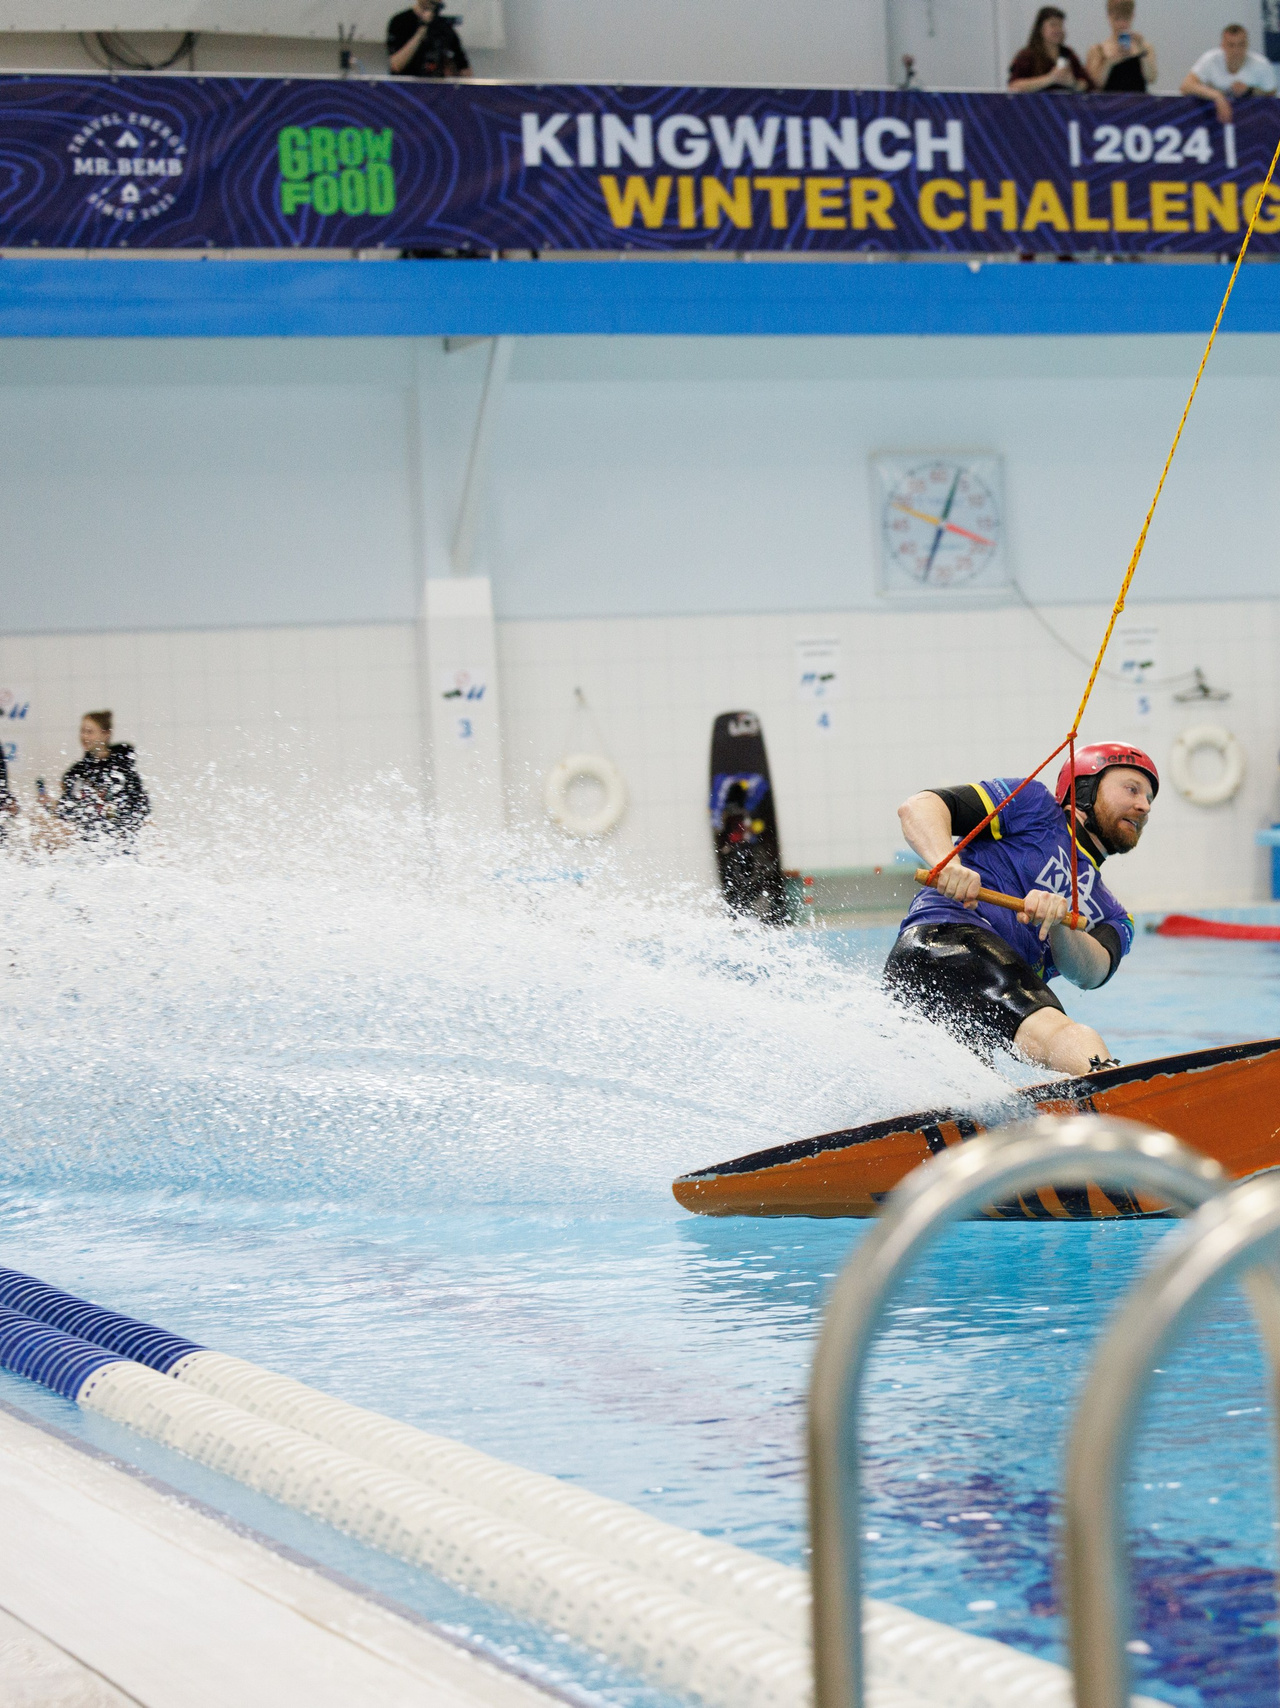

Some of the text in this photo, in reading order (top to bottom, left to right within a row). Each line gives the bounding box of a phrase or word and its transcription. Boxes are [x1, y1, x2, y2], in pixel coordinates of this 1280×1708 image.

[67, 112, 187, 154] TRAVEL ENERGY
[277, 125, 394, 180] GROW
[520, 112, 965, 172] KINGWINCH
[74, 156, 184, 177] MR.BEMB
[280, 164, 396, 217] FOOD
[599, 175, 896, 230] WINTER
[816, 711, 832, 729] 4
